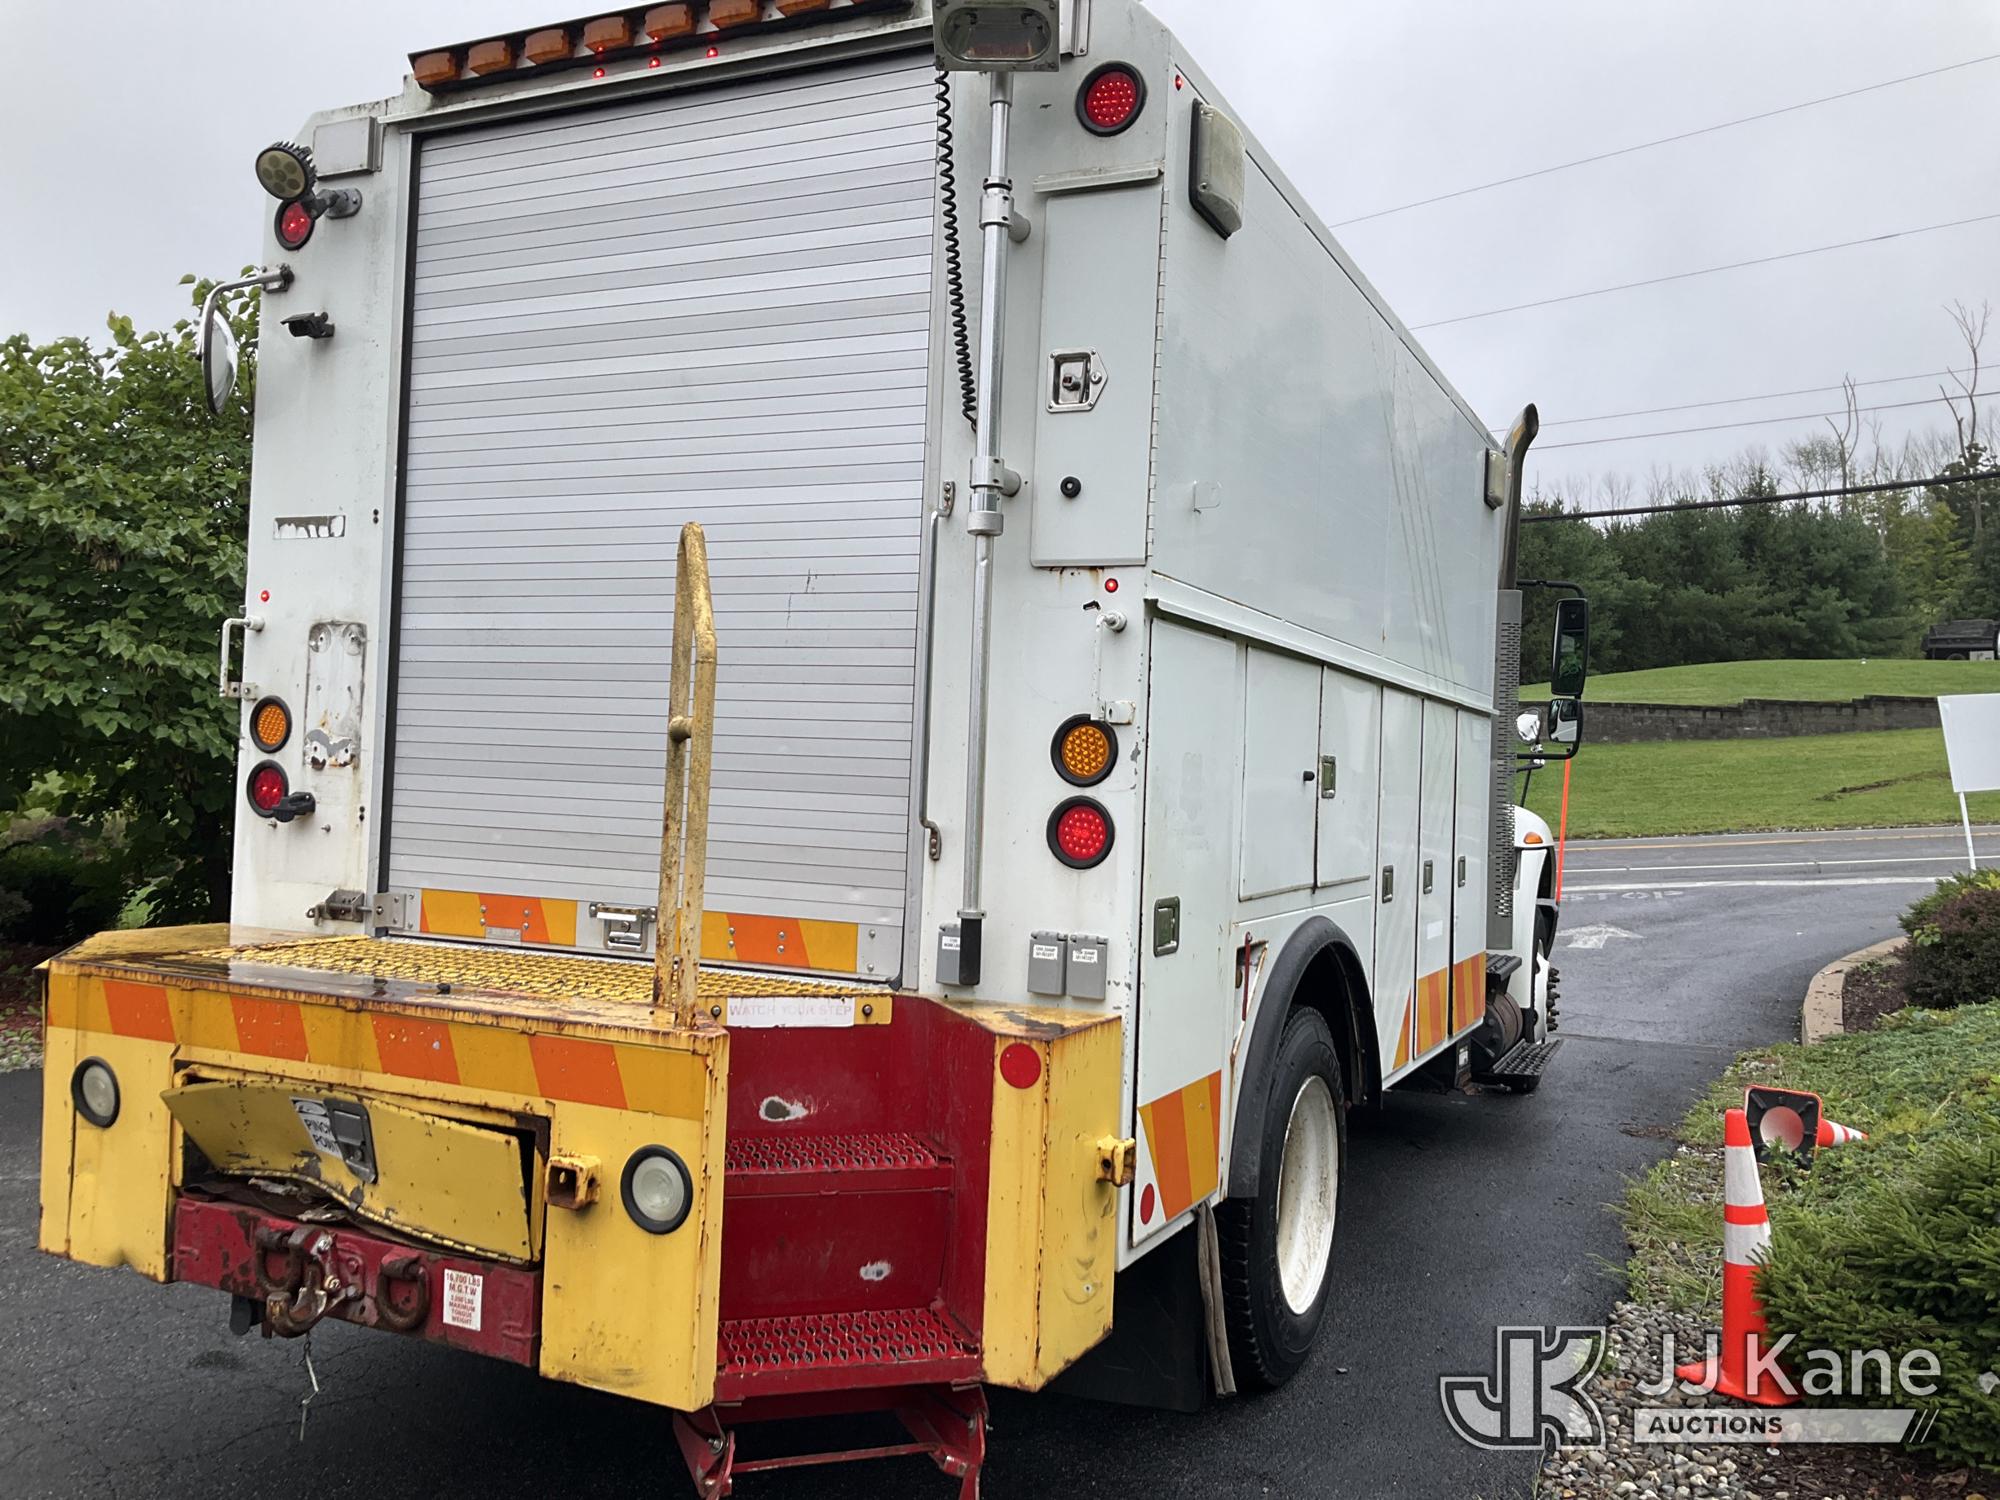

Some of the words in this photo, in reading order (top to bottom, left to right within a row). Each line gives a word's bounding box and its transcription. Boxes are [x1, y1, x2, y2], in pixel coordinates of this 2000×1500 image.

[729, 1004, 776, 1016] WATCH
[781, 1004, 815, 1016] YOUR
[818, 1004, 852, 1016] STEP
